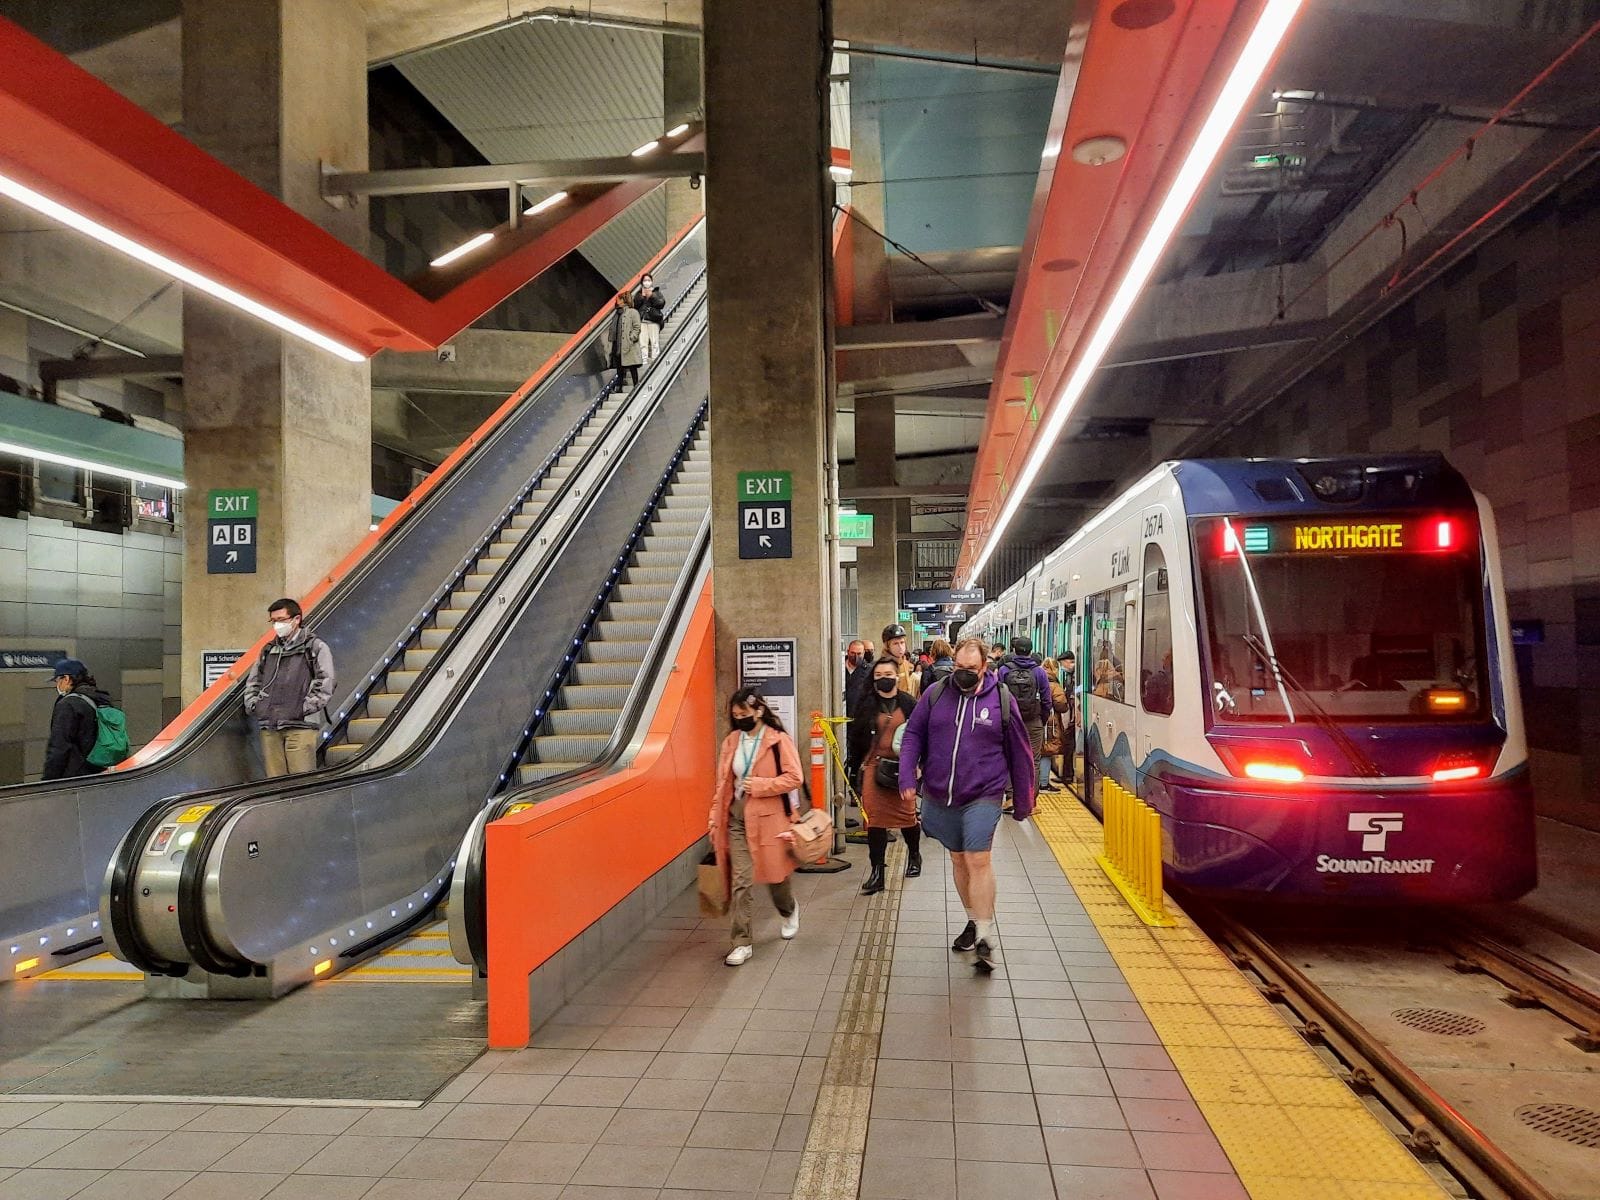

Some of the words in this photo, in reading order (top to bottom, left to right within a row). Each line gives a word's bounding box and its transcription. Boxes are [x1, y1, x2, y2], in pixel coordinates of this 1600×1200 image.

[745, 478, 782, 494] EXIT
[215, 496, 249, 511] EXIT
[747, 511, 759, 526] A
[771, 511, 781, 525] B
[1144, 512, 1163, 538] 267A
[216, 528, 227, 542] A
[238, 527, 247, 541] B
[1295, 524, 1402, 550] NORTHGATE
[1117, 546, 1131, 576] Link
